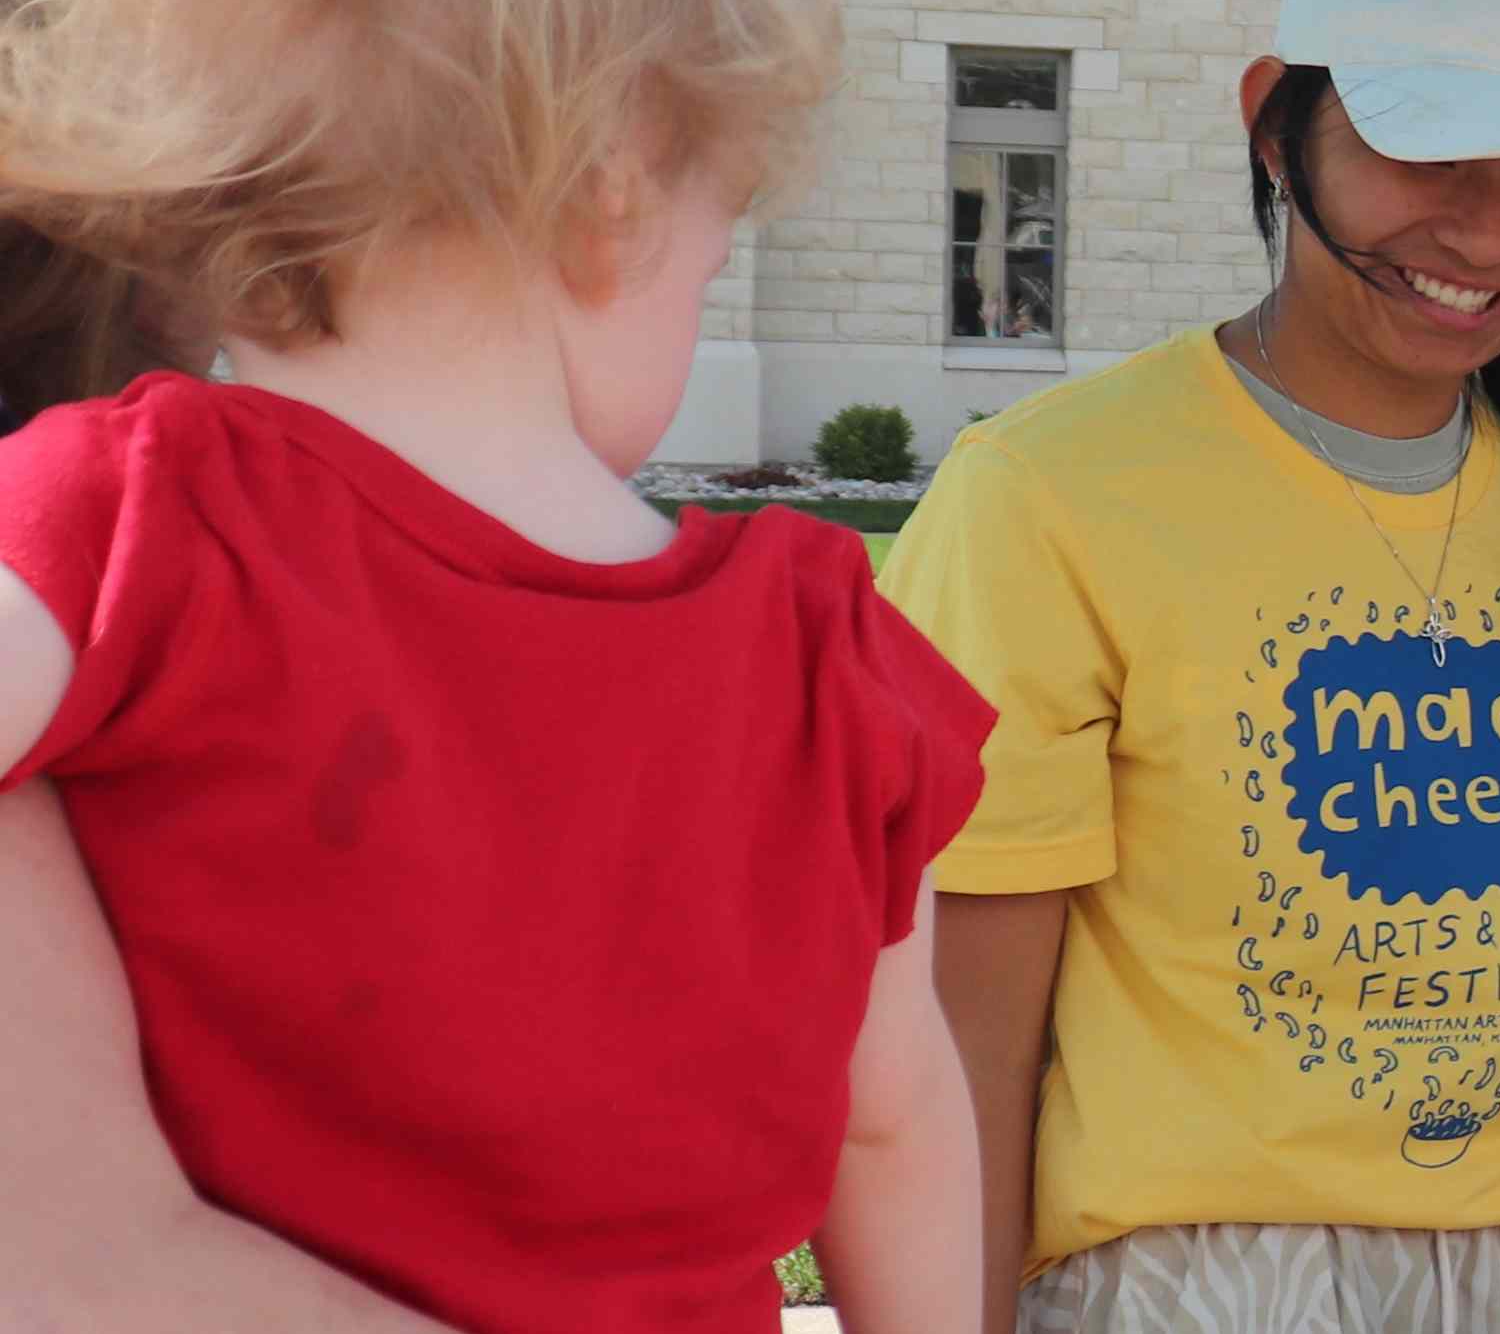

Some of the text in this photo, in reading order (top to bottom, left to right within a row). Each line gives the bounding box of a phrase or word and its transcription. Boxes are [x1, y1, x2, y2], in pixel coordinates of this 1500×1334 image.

[1334, 914, 1461, 965] ARTS
[1476, 912, 1497, 946] &
[1364, 1016, 1468, 1031] MANHATTAN
